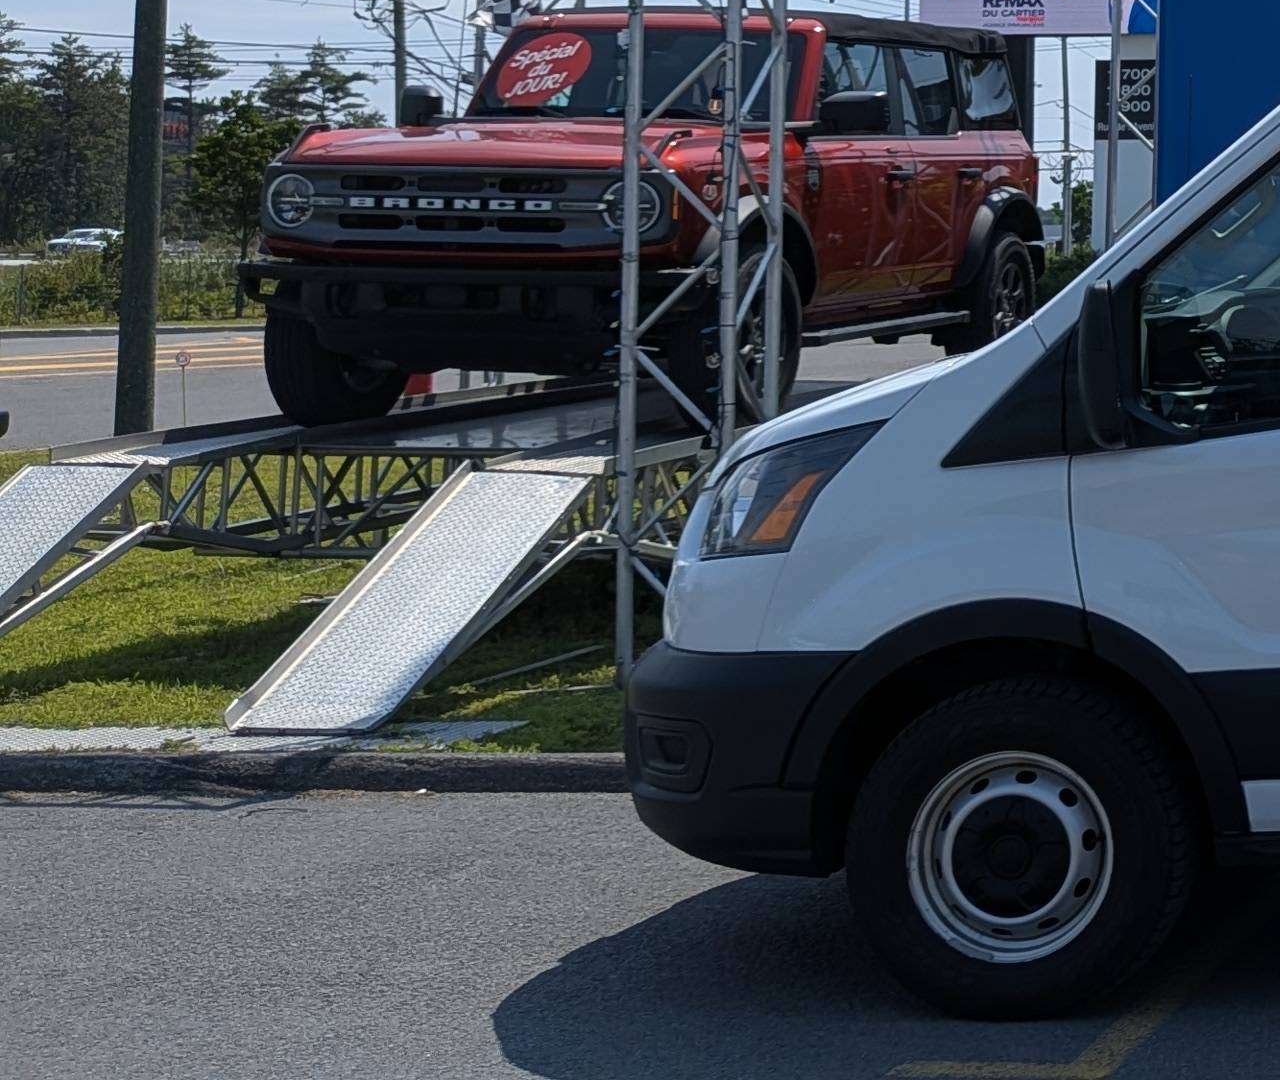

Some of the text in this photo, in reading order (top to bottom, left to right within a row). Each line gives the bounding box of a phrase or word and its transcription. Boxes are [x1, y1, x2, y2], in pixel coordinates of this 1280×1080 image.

[982, 9, 998, 18] DU
[510, 40, 583, 70] Spécial
[528, 61, 555, 77] du
[505, 71, 568, 98] JOUR!
[350, 196, 553, 211] BRONCO
